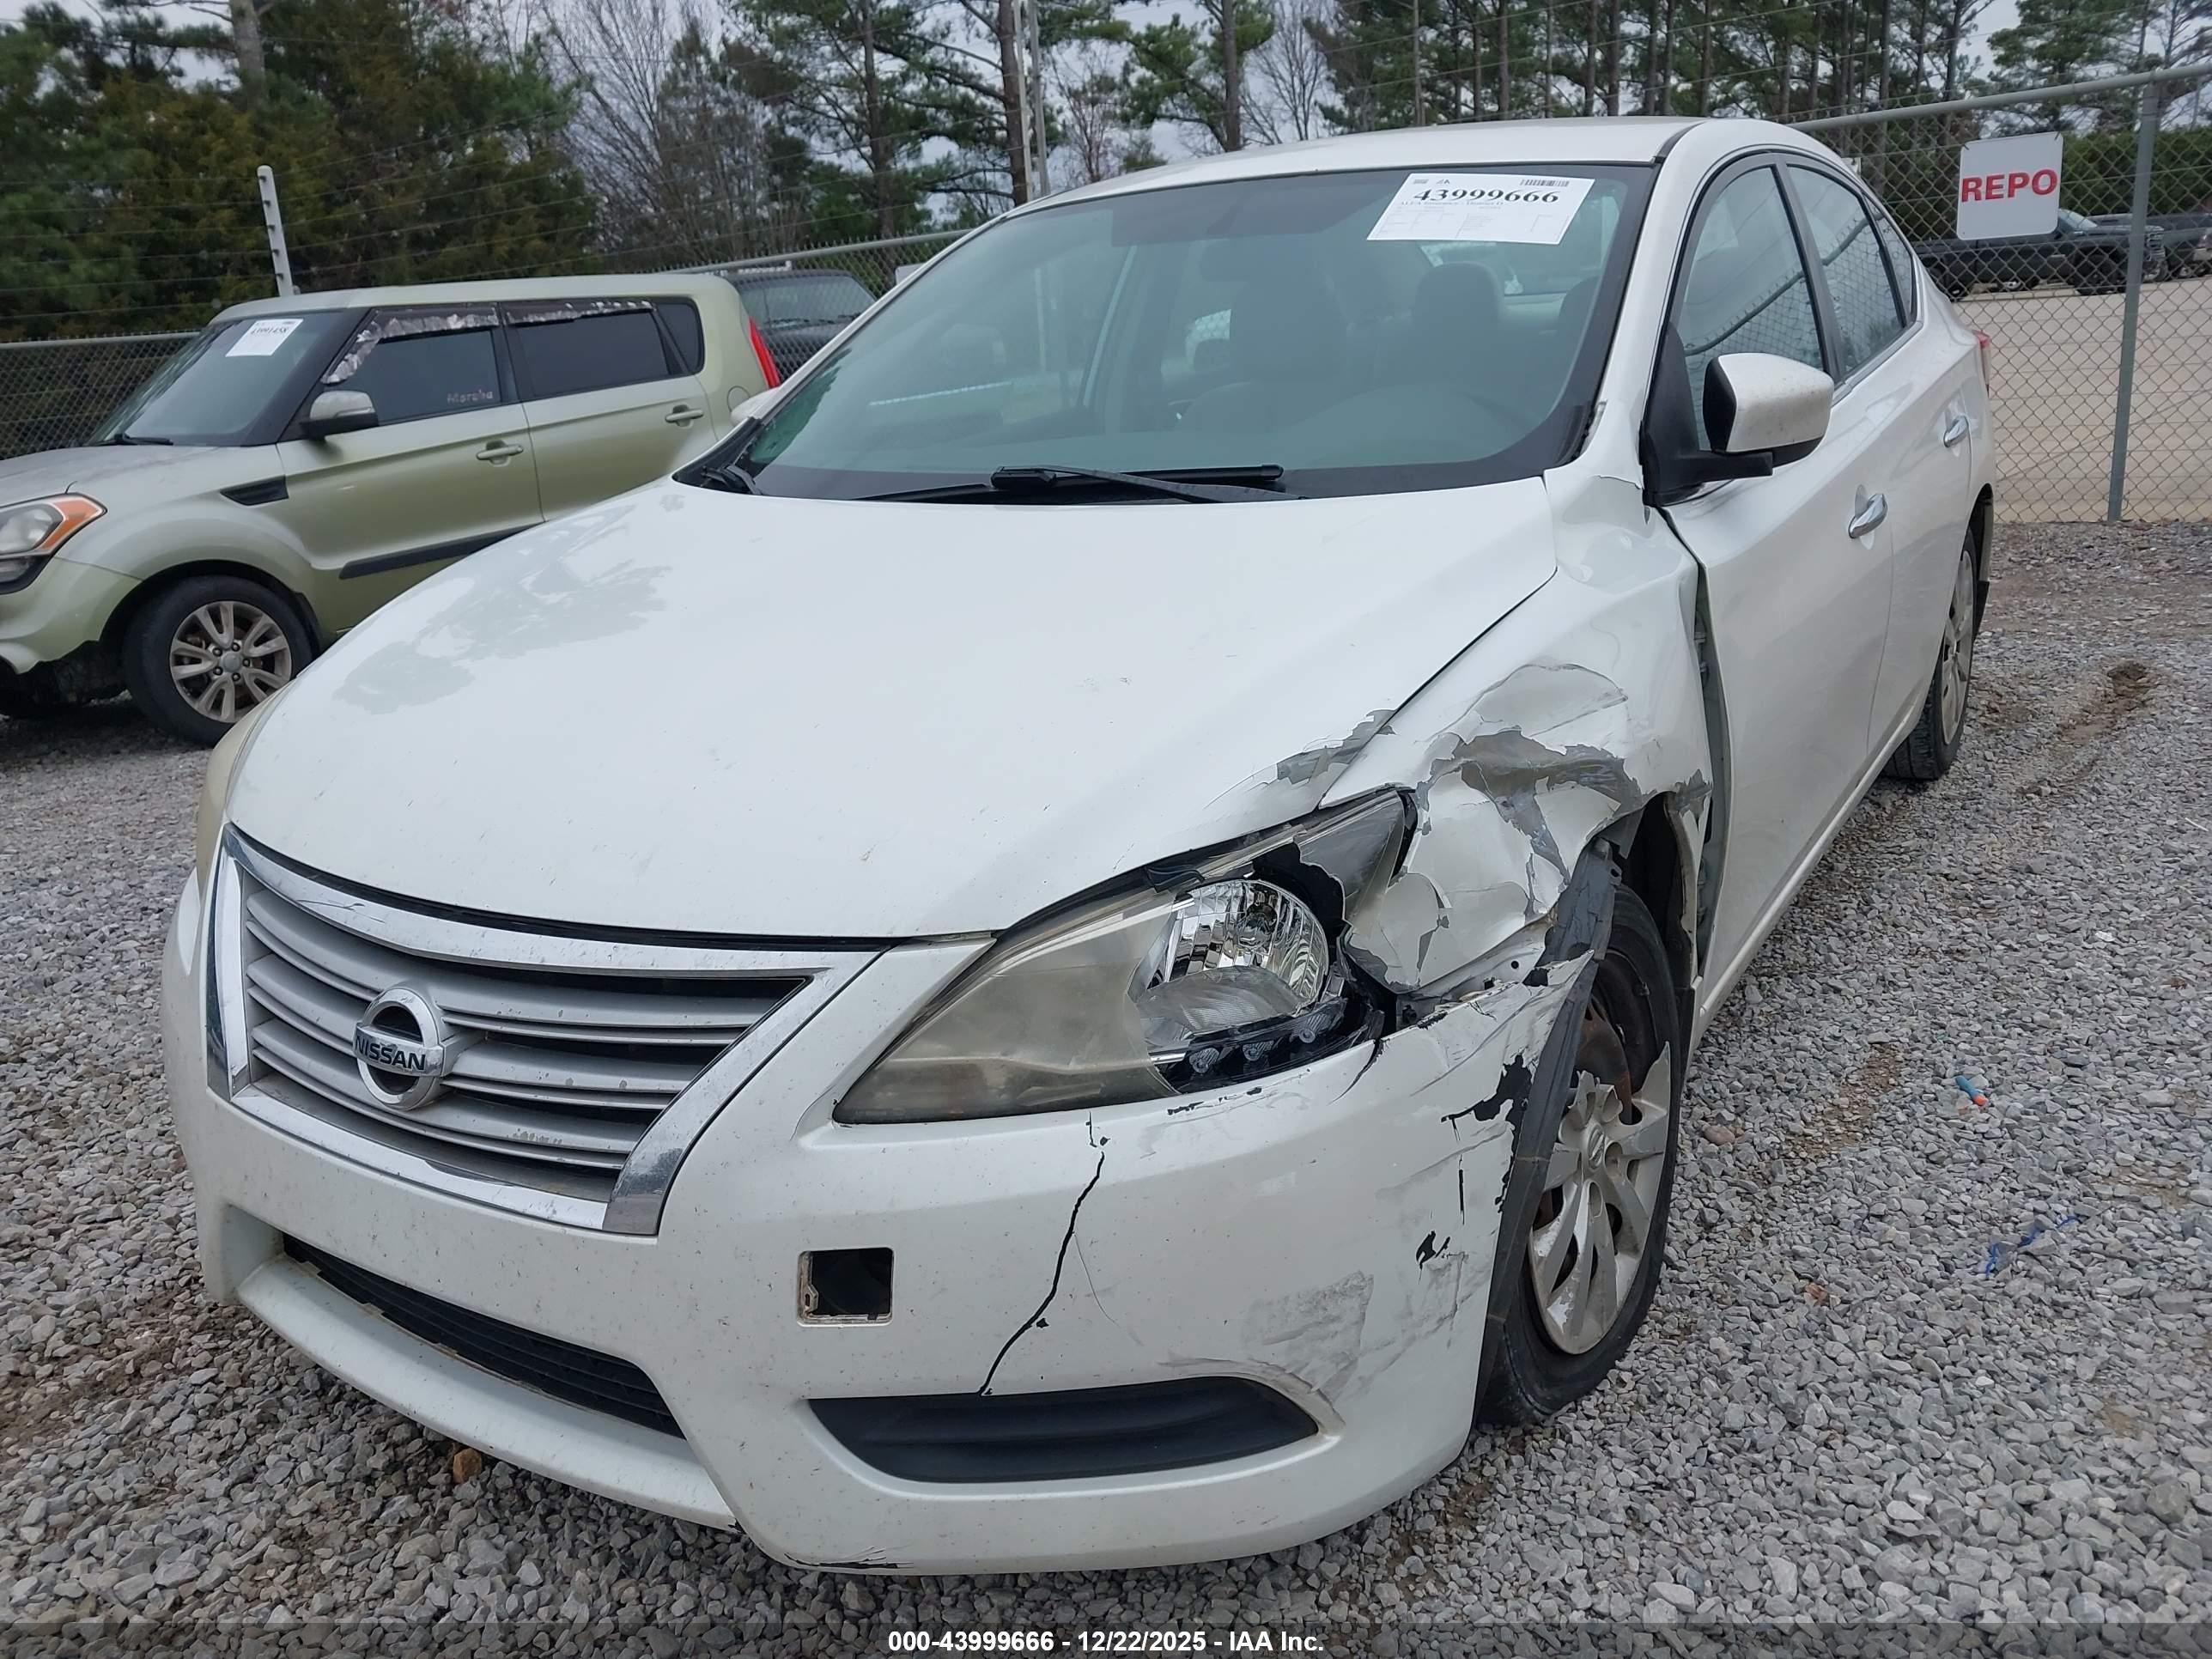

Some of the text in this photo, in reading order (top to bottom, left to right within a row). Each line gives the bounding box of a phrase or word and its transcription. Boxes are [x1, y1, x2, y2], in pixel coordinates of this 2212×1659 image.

[1413, 189, 1559, 203] 43999666
[1961, 169, 2057, 203] REPO
[356, 1036, 426, 1071] NISSAN
